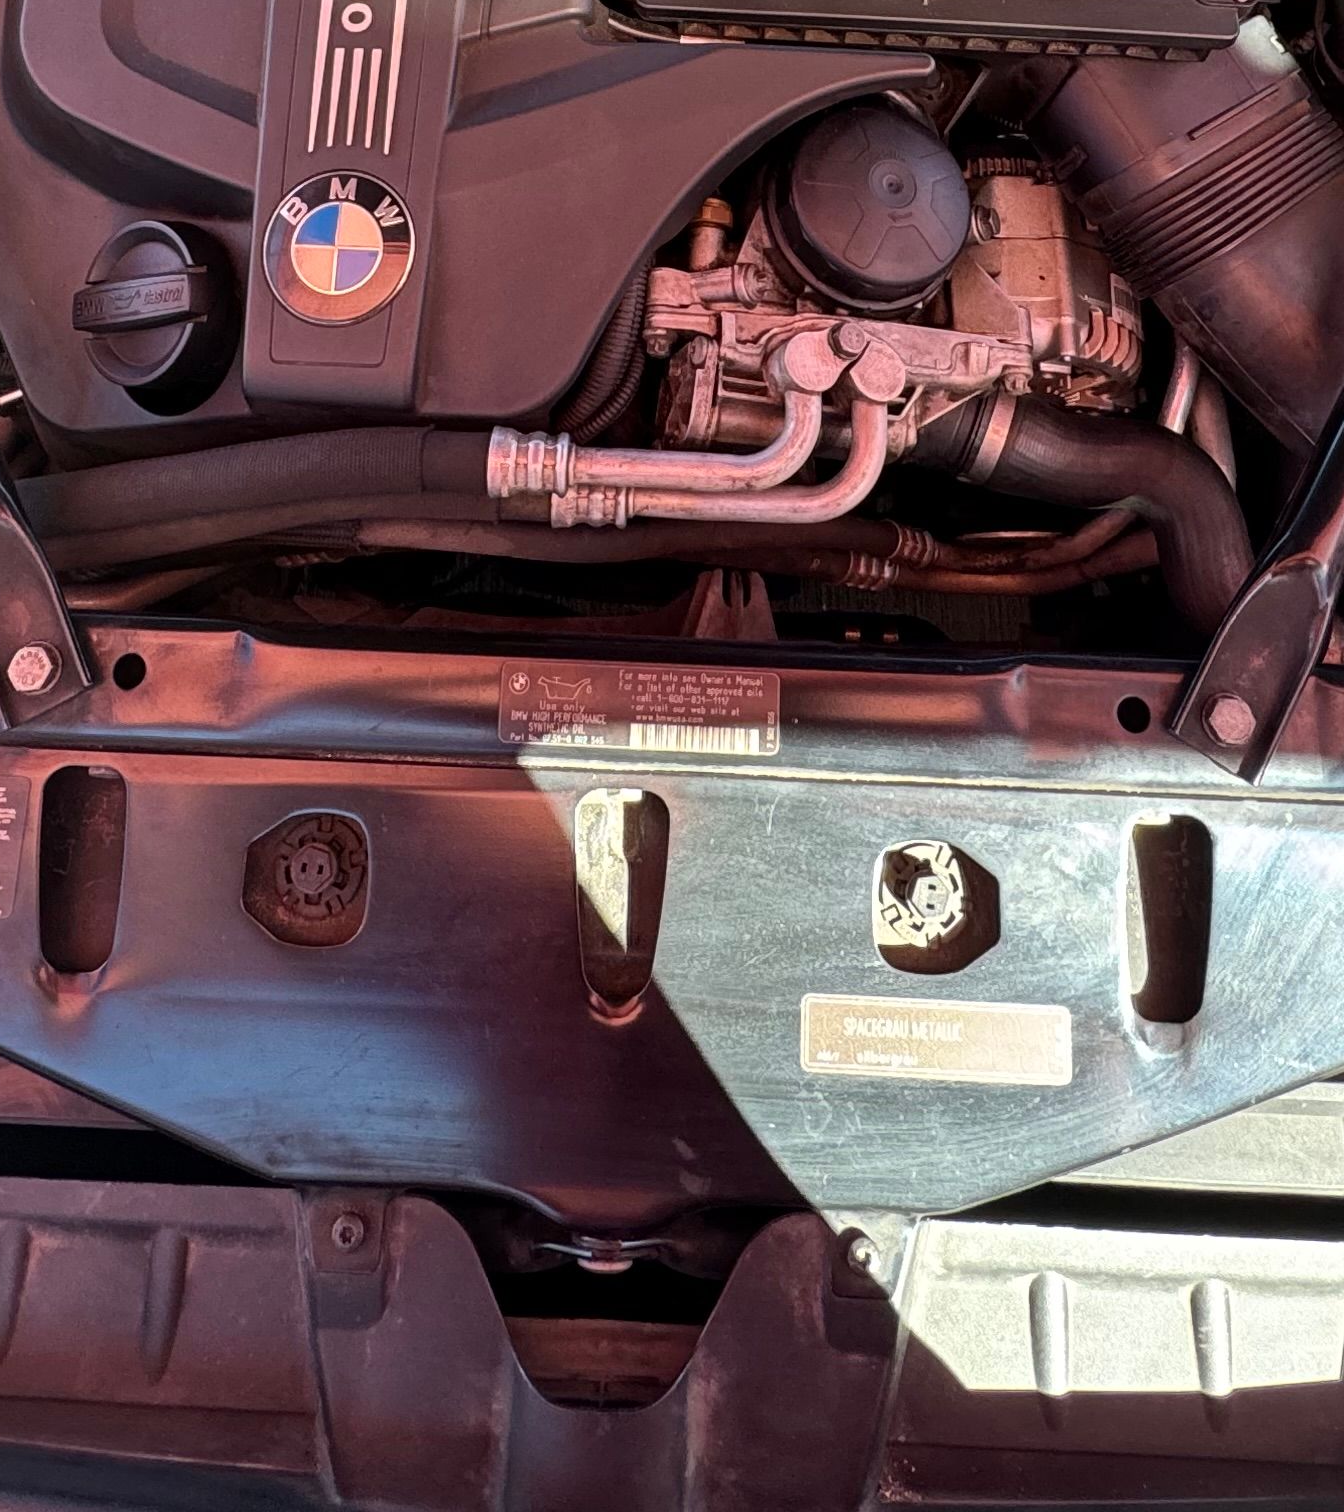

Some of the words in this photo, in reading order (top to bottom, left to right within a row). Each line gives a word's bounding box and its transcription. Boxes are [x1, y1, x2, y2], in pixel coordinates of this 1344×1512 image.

[280, 177, 405, 227] BMW
[619, 670, 633, 680] For
[638, 673, 657, 682] more
[662, 672, 678, 682] info
[682, 674, 696, 683] see
[700, 673, 731, 685] Owner's
[736, 675, 763, 686] Manual
[647, 681, 661, 692] list
[666, 682, 675, 693] of
[680, 683, 701, 694] other
[706, 686, 743, 696] approved
[747, 687, 763, 697] oils
[539, 700, 557, 710] Use
[563, 701, 586, 713] only
[649, 704, 668, 713] visit
[691, 706, 706, 714] web
[710, 706, 726, 716] site
[731, 707, 740, 716] at
[511, 710, 528, 721] BMW
[532, 711, 550, 722] HIGH
[553, 712, 607, 725] PERFORMANCE
[528, 722, 569, 733] SYNTHETIC
[572, 724, 585, 734] OIL
[510, 733, 524, 741] Part
[843, 1016, 909, 1039] SPACEGRAU
